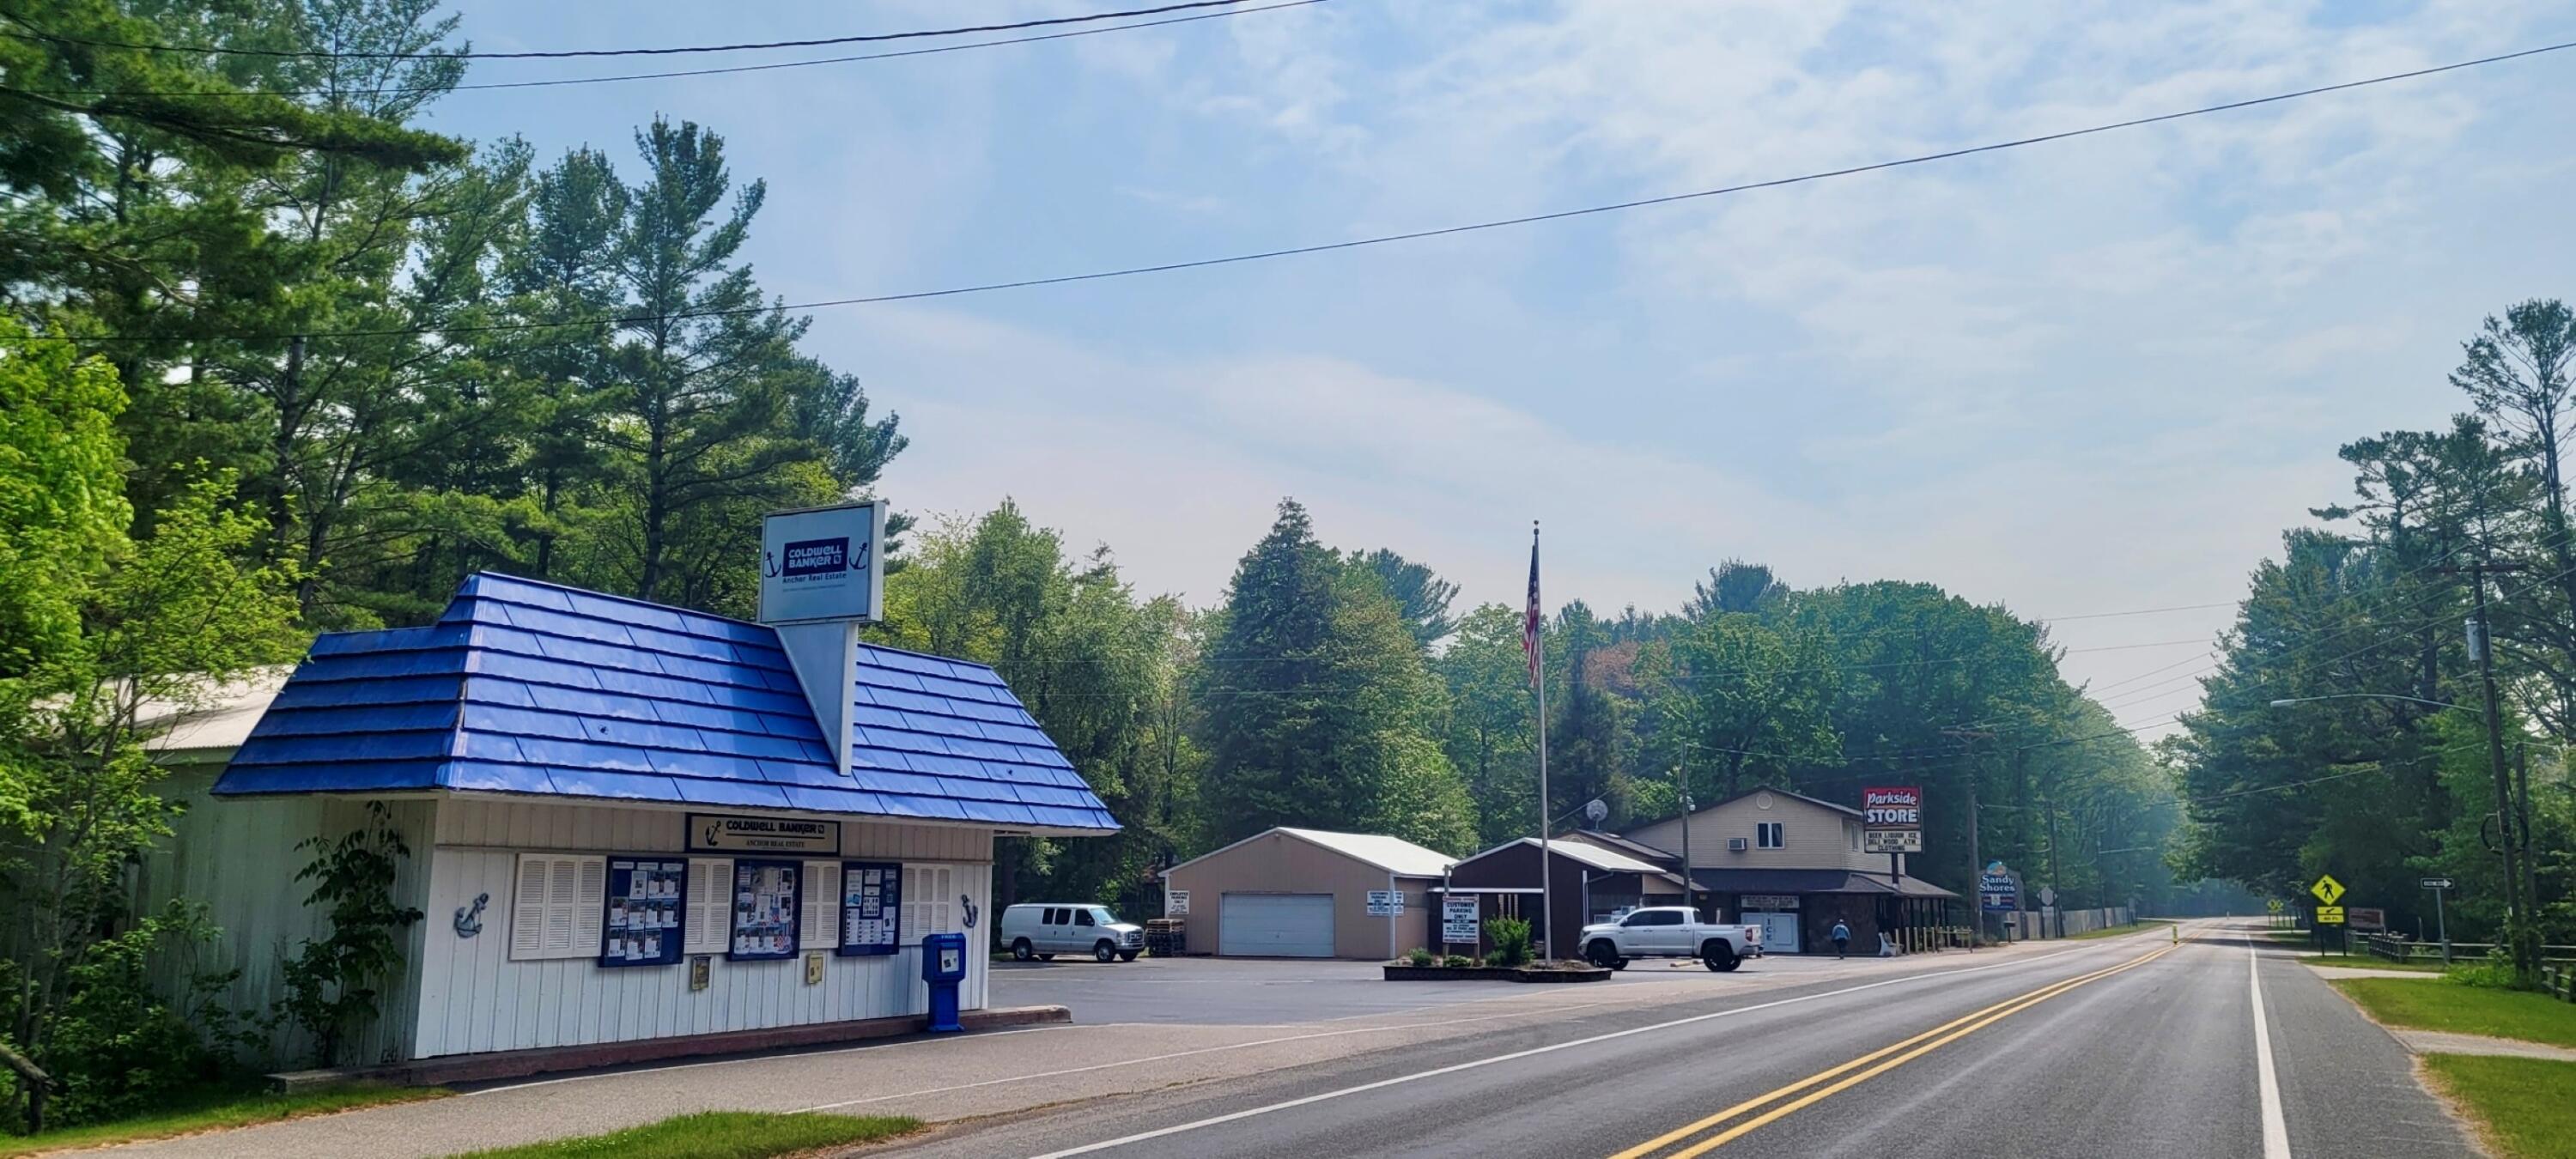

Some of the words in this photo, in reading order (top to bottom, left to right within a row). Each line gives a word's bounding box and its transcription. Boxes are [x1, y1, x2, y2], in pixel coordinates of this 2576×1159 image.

[788, 544, 842, 559] COLDWELL
[788, 555, 831, 568] BANKER
[782, 575, 806, 585] Anchor
[808, 573, 823, 582] Real
[824, 572, 848, 581] Estate
[1867, 791, 1917, 809] Parkside
[1867, 809, 1917, 823] STORE
[726, 820, 775, 832] COLDWELL
[779, 822, 817, 834] BANKER
[746, 839, 771, 847] ANCHOR
[770, 840, 785, 848] REAL
[785, 840, 805, 849] ESTATE
[1982, 874, 2014, 886] Sandy
[1979, 883, 2016, 892] Shores
